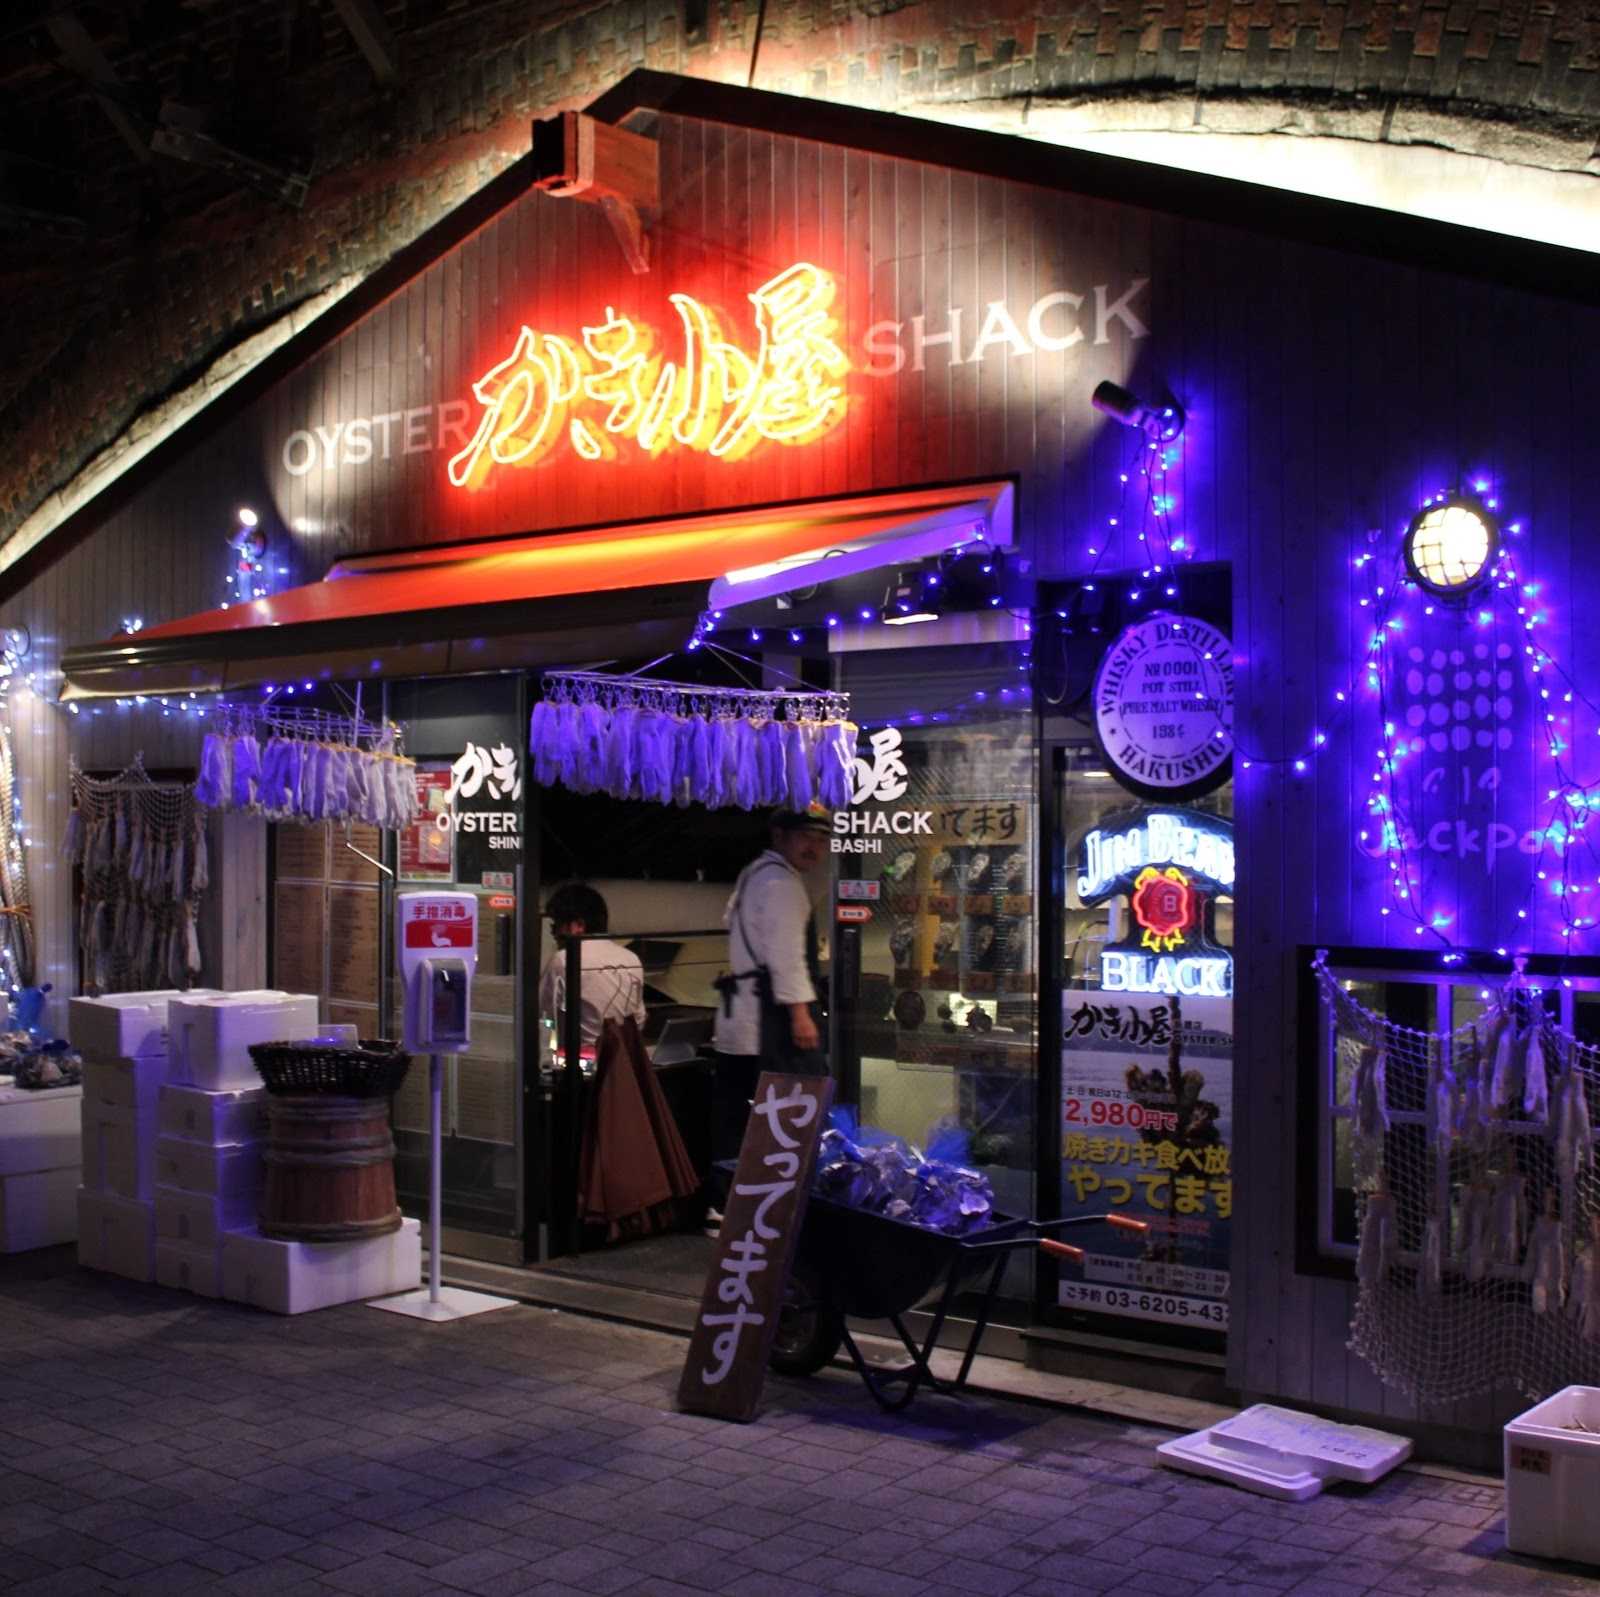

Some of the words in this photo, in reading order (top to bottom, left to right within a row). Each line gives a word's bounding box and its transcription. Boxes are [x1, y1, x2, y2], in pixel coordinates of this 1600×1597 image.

[861, 277, 1152, 379] SHACK
[447, 262, 856, 492] かき小屋
[282, 400, 471, 477] OYSTER
[1101, 630, 1147, 716] WHISKY
[1163, 660, 1198, 676] 0001
[1142, 682, 1165, 693] POT
[1122, 700, 1150, 715] PURE
[1150, 700, 1179, 714] MALT
[1119, 738, 1226, 781] HAKUSHU
[435, 812, 517, 833] OYSTER
[833, 811, 934, 835] SHACK
[488, 836, 520, 849] SHIN
[830, 839, 882, 854] BASHI
[1100, 952, 1229, 997] BLACK
[1064, 1002, 1172, 1045] かき小屋
[1065, 1098, 1178, 1131] 2,980円で
[702, 1083, 817, 1385] やってます
